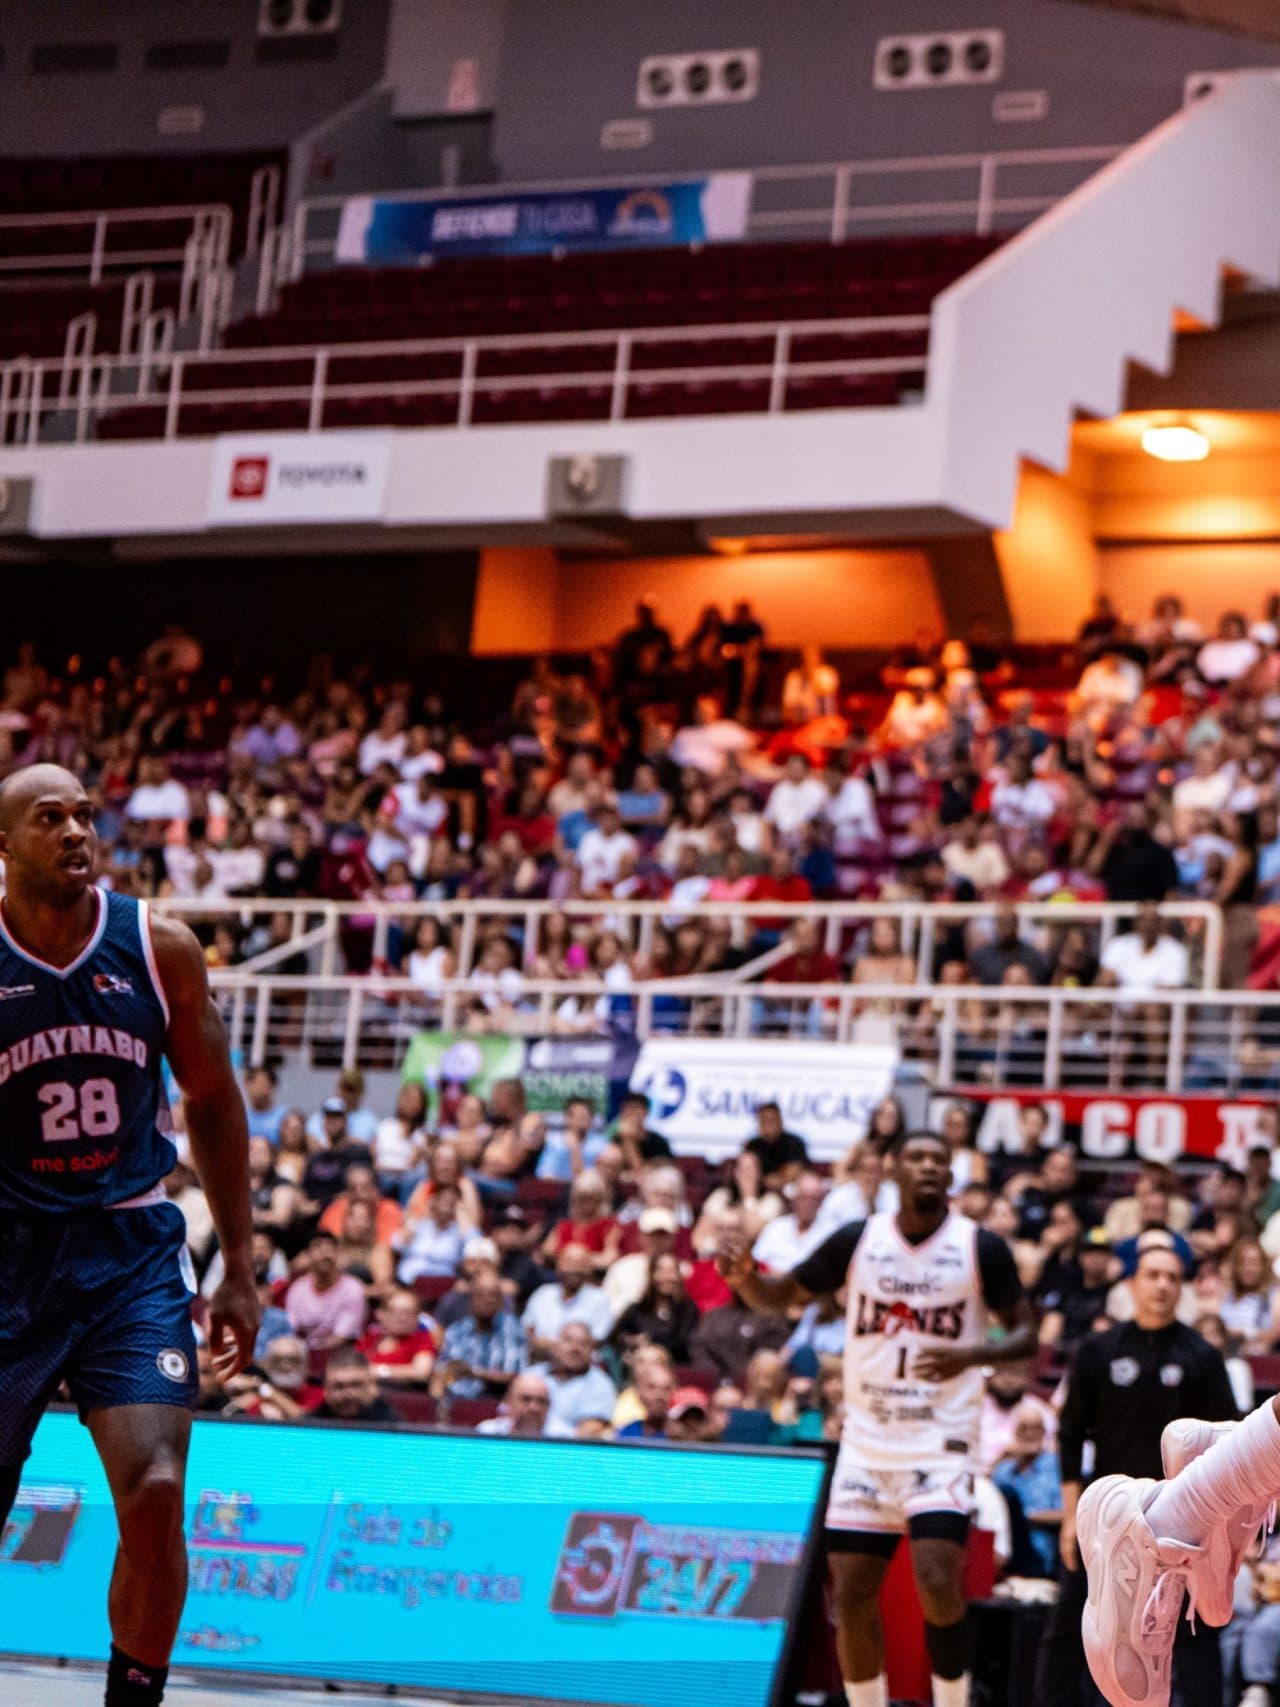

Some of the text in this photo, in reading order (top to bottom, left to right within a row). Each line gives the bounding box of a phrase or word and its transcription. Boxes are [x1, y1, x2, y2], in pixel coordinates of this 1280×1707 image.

[279, 462, 366, 486] TOYOTA
[37, 1077, 121, 1142] 28
[31, 1157, 65, 1173] me
